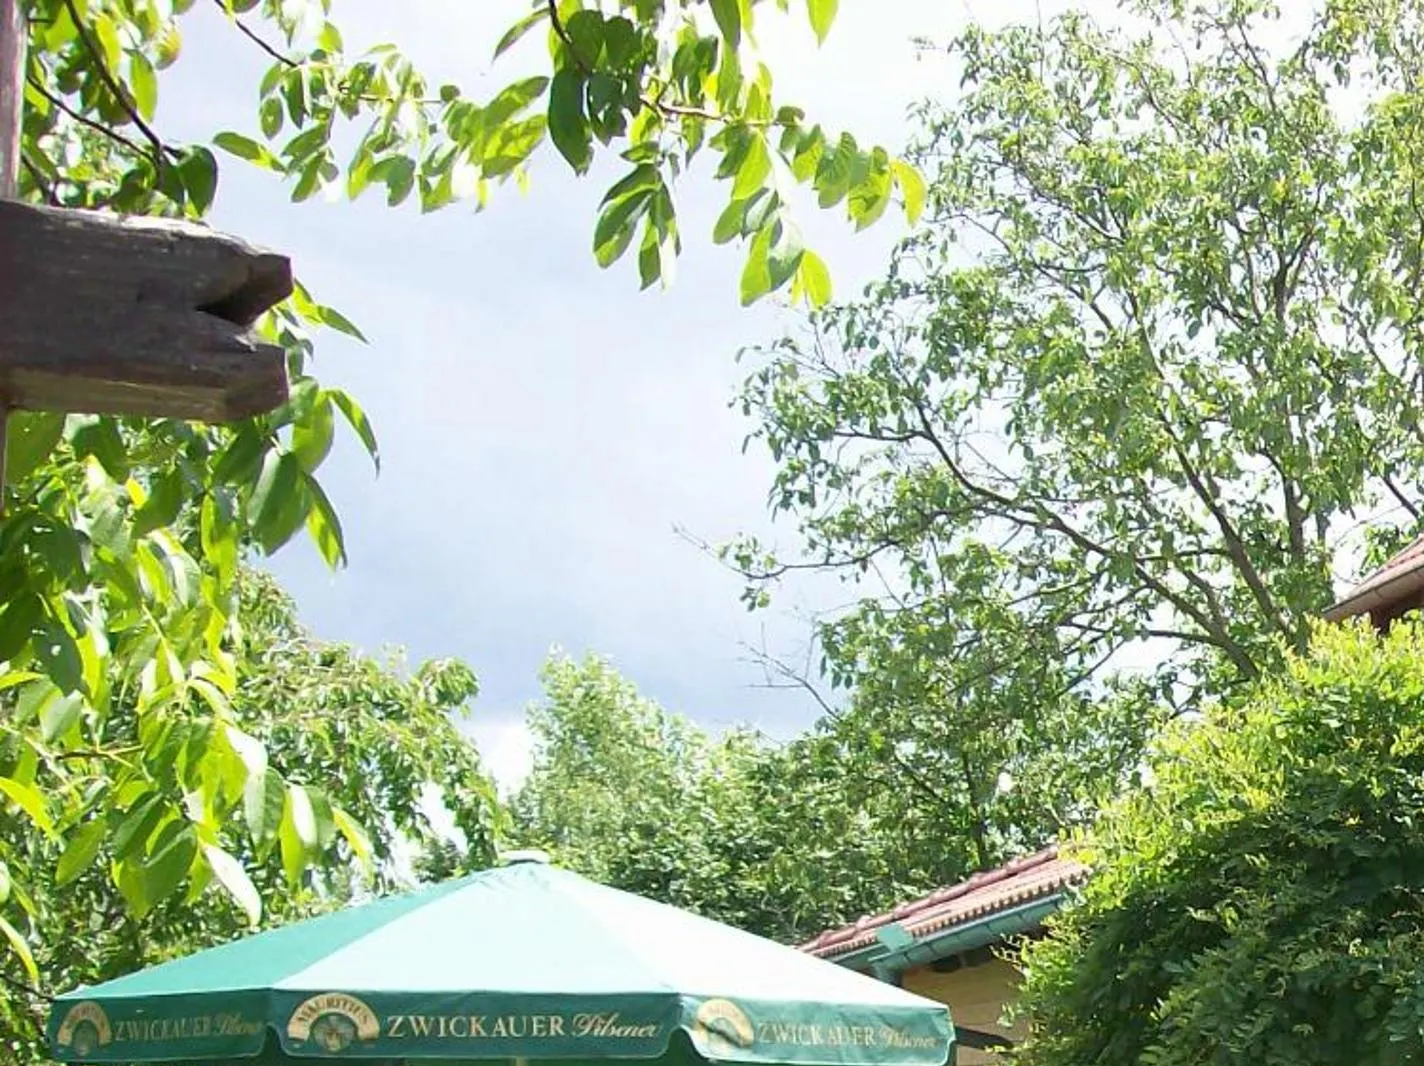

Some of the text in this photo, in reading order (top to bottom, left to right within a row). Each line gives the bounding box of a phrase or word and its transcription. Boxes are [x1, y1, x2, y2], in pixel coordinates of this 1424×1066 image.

[115, 1015, 211, 1040] ZWICKAUER
[388, 1012, 658, 1038] ZWICKAUER Pilsener
[760, 1023, 875, 1047] ZWICKAUER
